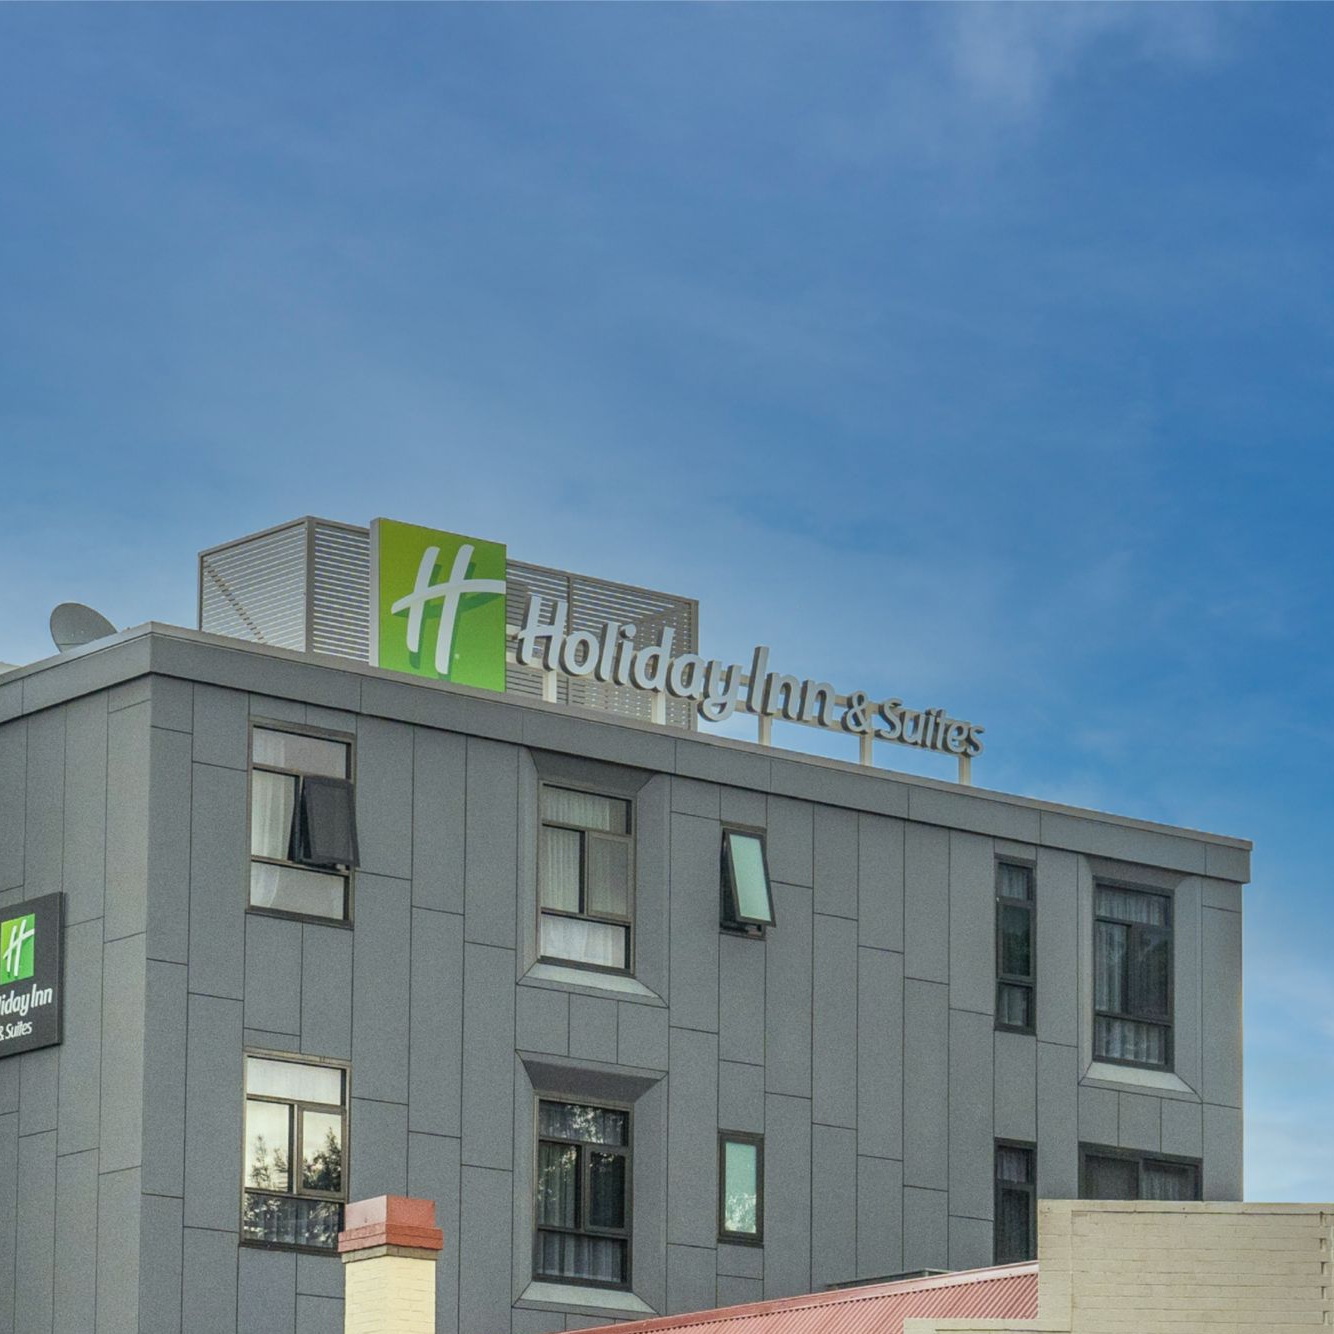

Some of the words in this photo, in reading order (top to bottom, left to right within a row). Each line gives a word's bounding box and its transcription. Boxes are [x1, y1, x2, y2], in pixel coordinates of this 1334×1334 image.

[516, 595, 742, 722] Holiday
[746, 645, 836, 728] Inn
[840, 690, 870, 734] &
[869, 697, 985, 758] Suites
[31, 983, 53, 1009] Inn
[5, 1020, 33, 1039] Suites
